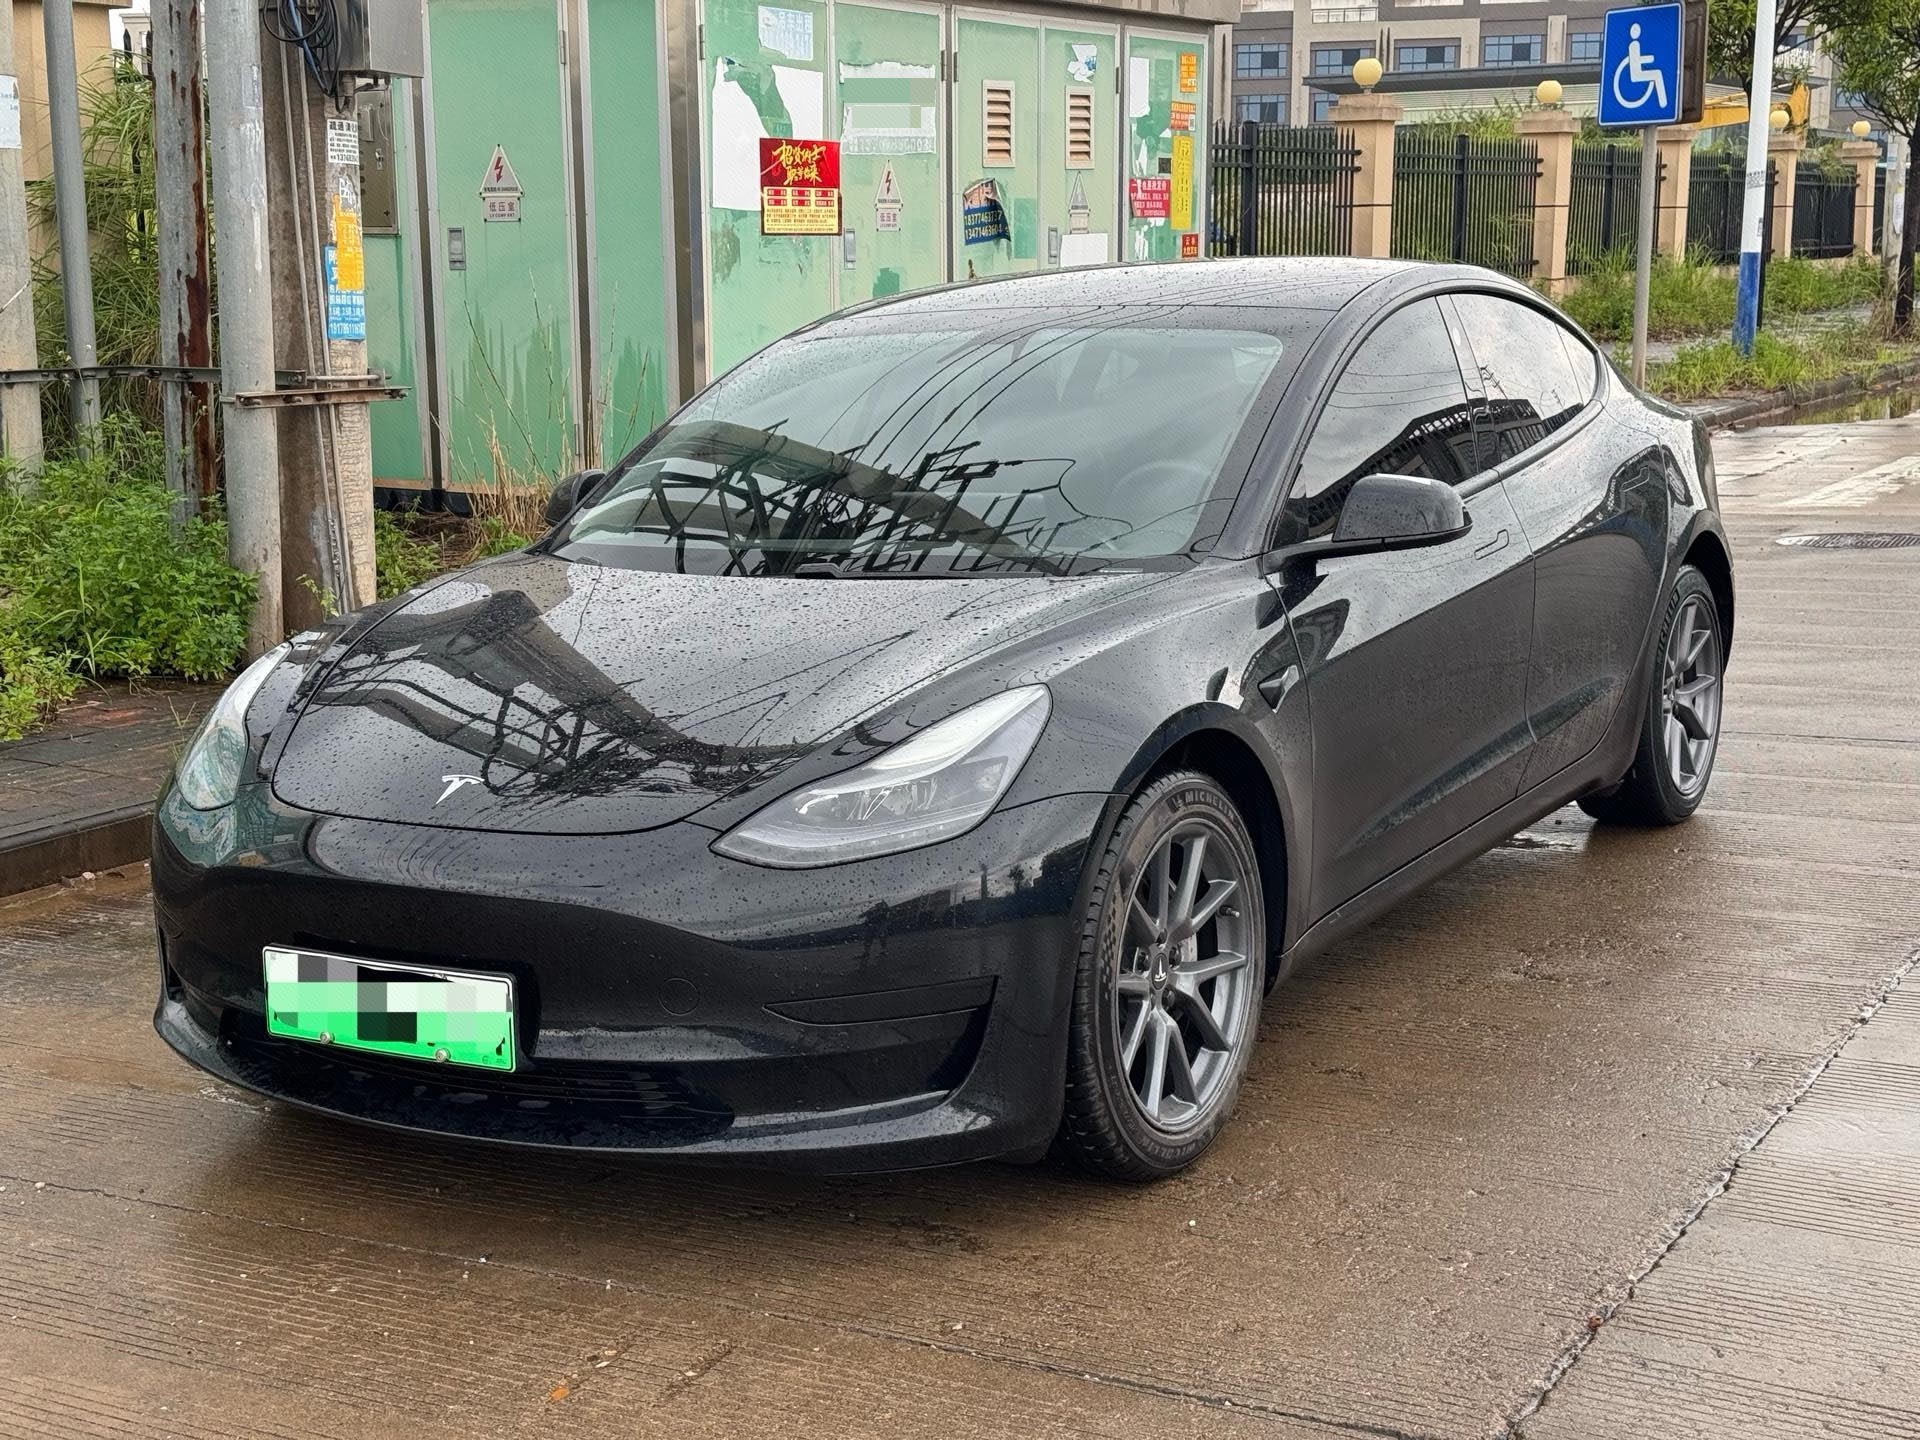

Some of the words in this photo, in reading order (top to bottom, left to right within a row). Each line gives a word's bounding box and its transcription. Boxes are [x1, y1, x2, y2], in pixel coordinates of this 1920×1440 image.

[489, 201, 515, 212] 低压室
[1185, 789, 1236, 822] MICHELIN
